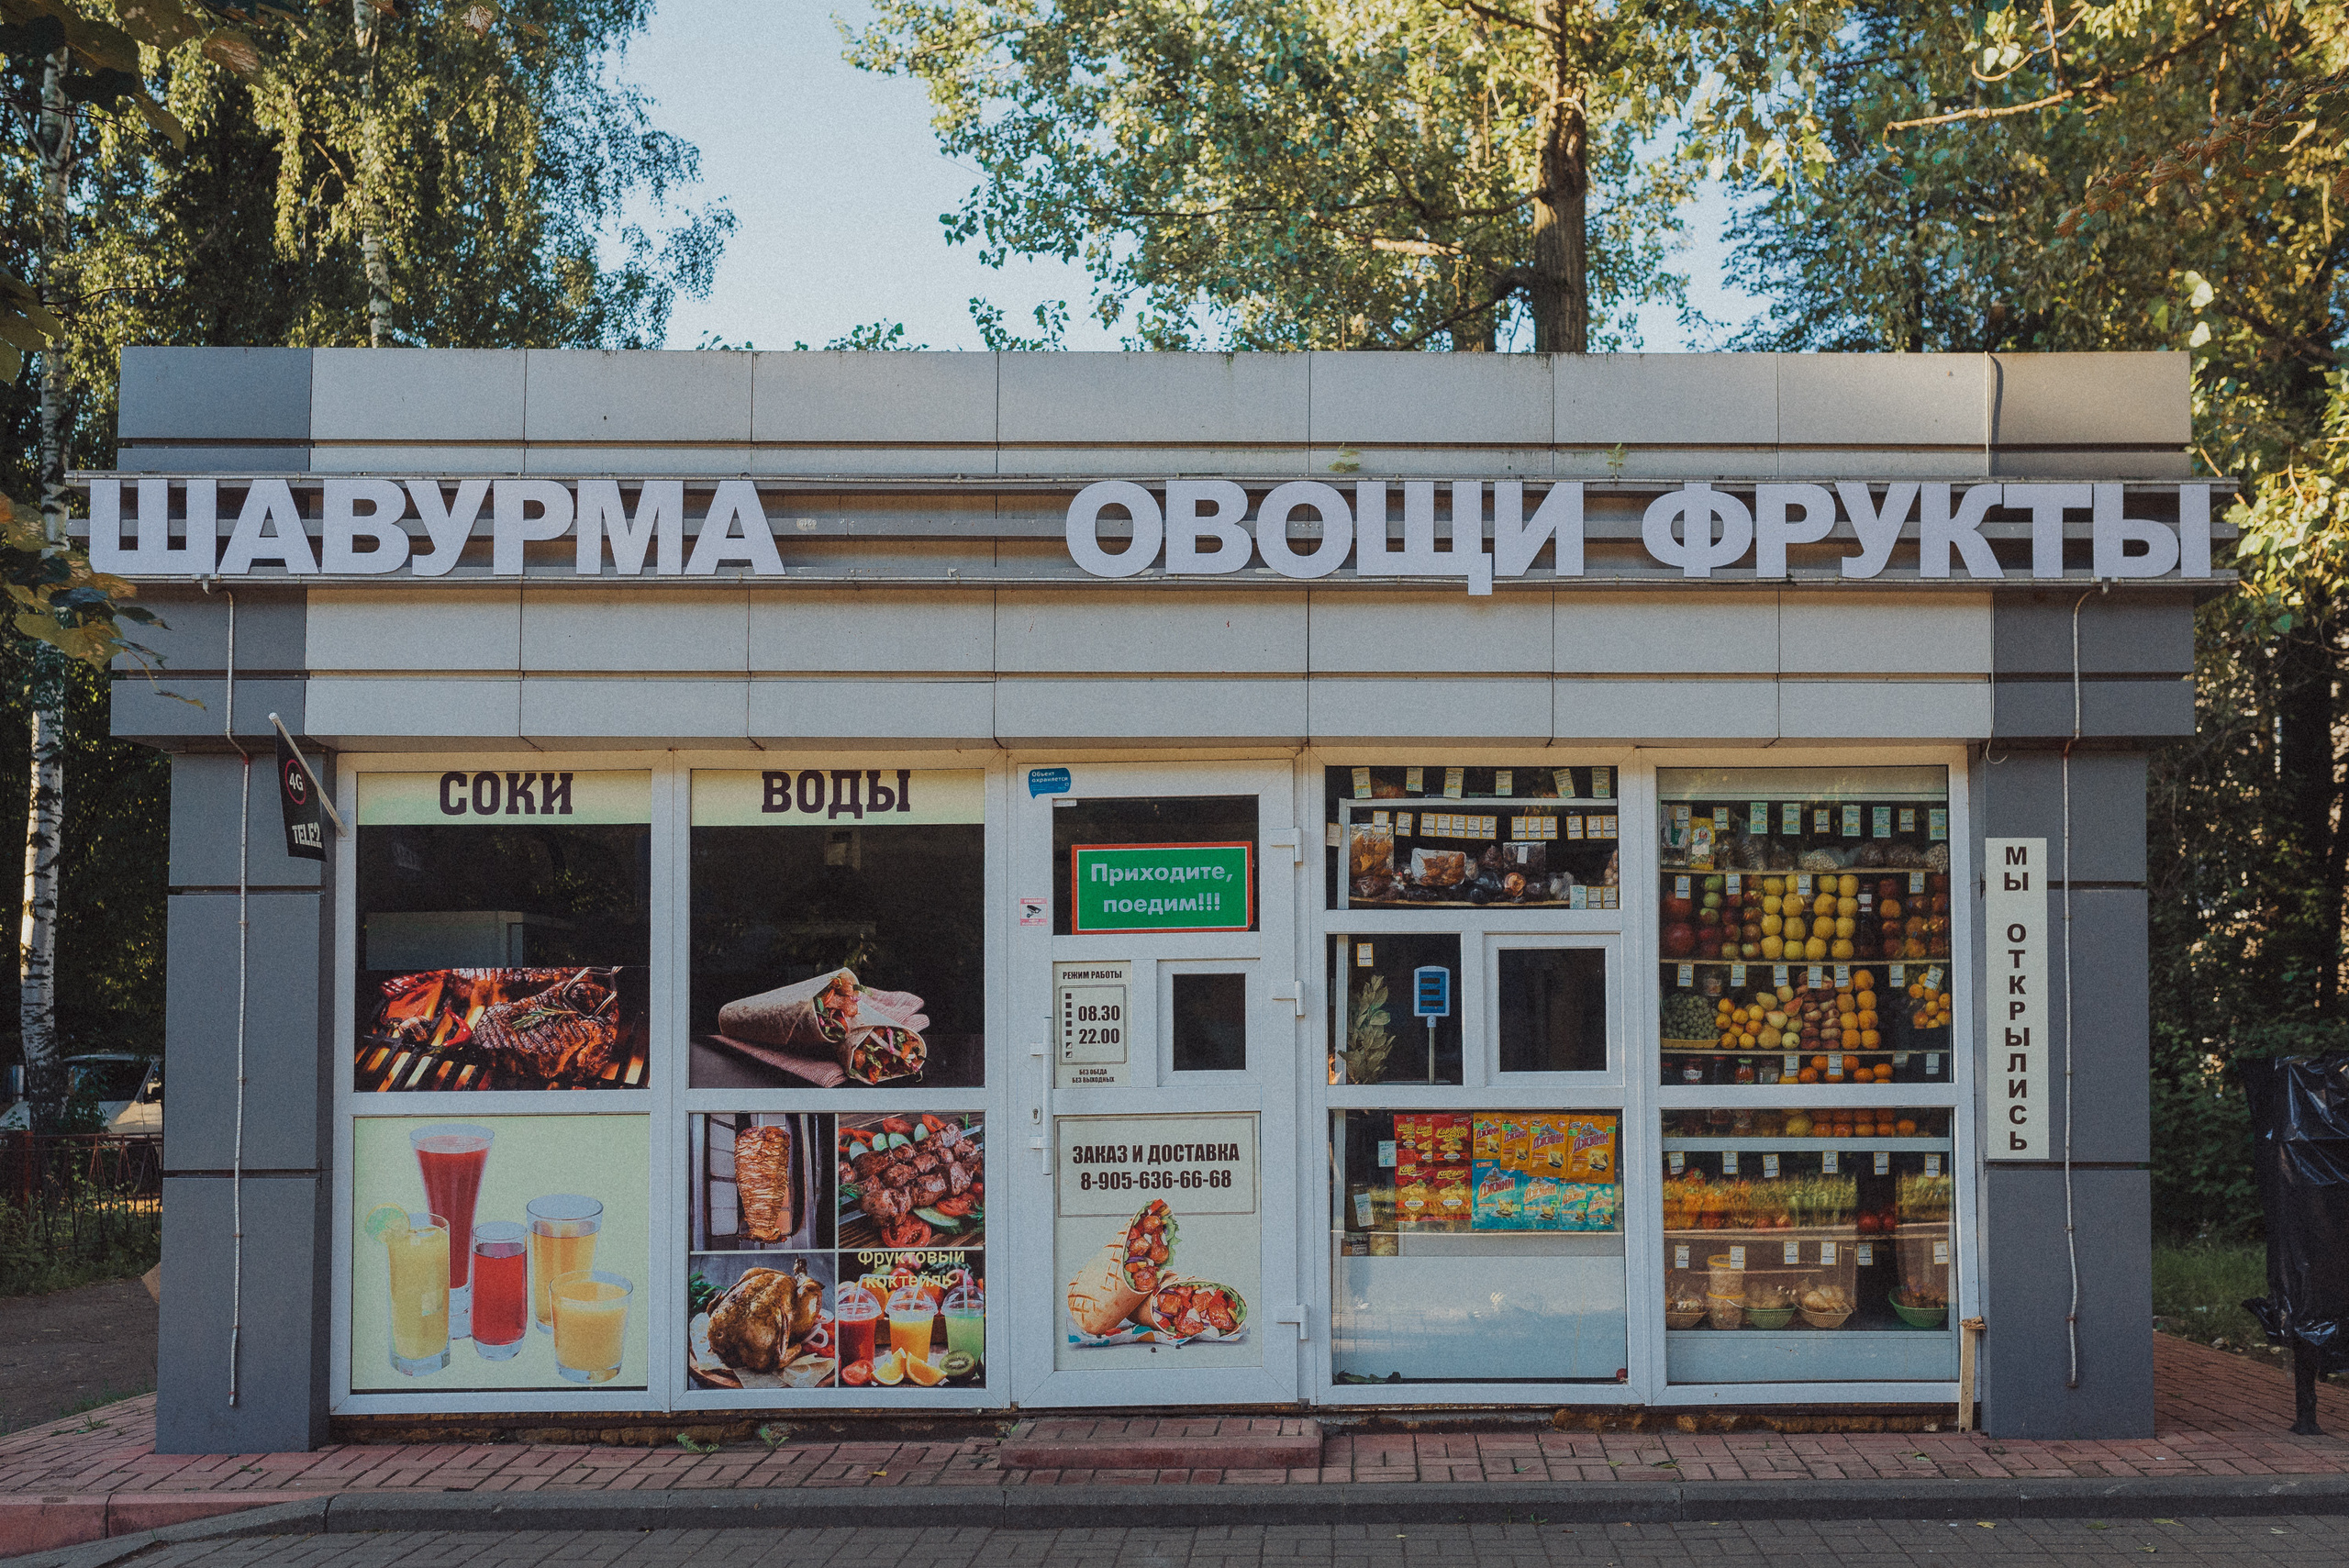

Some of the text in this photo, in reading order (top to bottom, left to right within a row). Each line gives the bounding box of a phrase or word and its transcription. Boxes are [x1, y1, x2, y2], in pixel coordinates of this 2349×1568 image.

[89, 478, 2211, 596] ШАВУРМА ОВОЩИ ФРУКТЫ
[289, 773, 304, 791] 4G
[440, 772, 573, 816] СОКИ
[761, 769, 911, 819] ВОДЫ
[292, 822, 322, 849] TELE2
[1090, 862, 1233, 886] Приходите,
[1103, 892, 1220, 916] поедим!!!
[1063, 970, 1122, 980] РЕЖИМ РАБОТЫ
[2003, 846, 2031, 1151] МЫ ОТКРЫЛИСЬ
[1078, 1005, 1120, 1022] 08.30
[1078, 1028, 1120, 1044] 22.00
[1073, 1143, 1240, 1165] ЗАКАЗ И ДОСТАВКА
[1080, 1170, 1232, 1190] 8-905-636-66-68
[865, 1271, 953, 1288] коктейль
